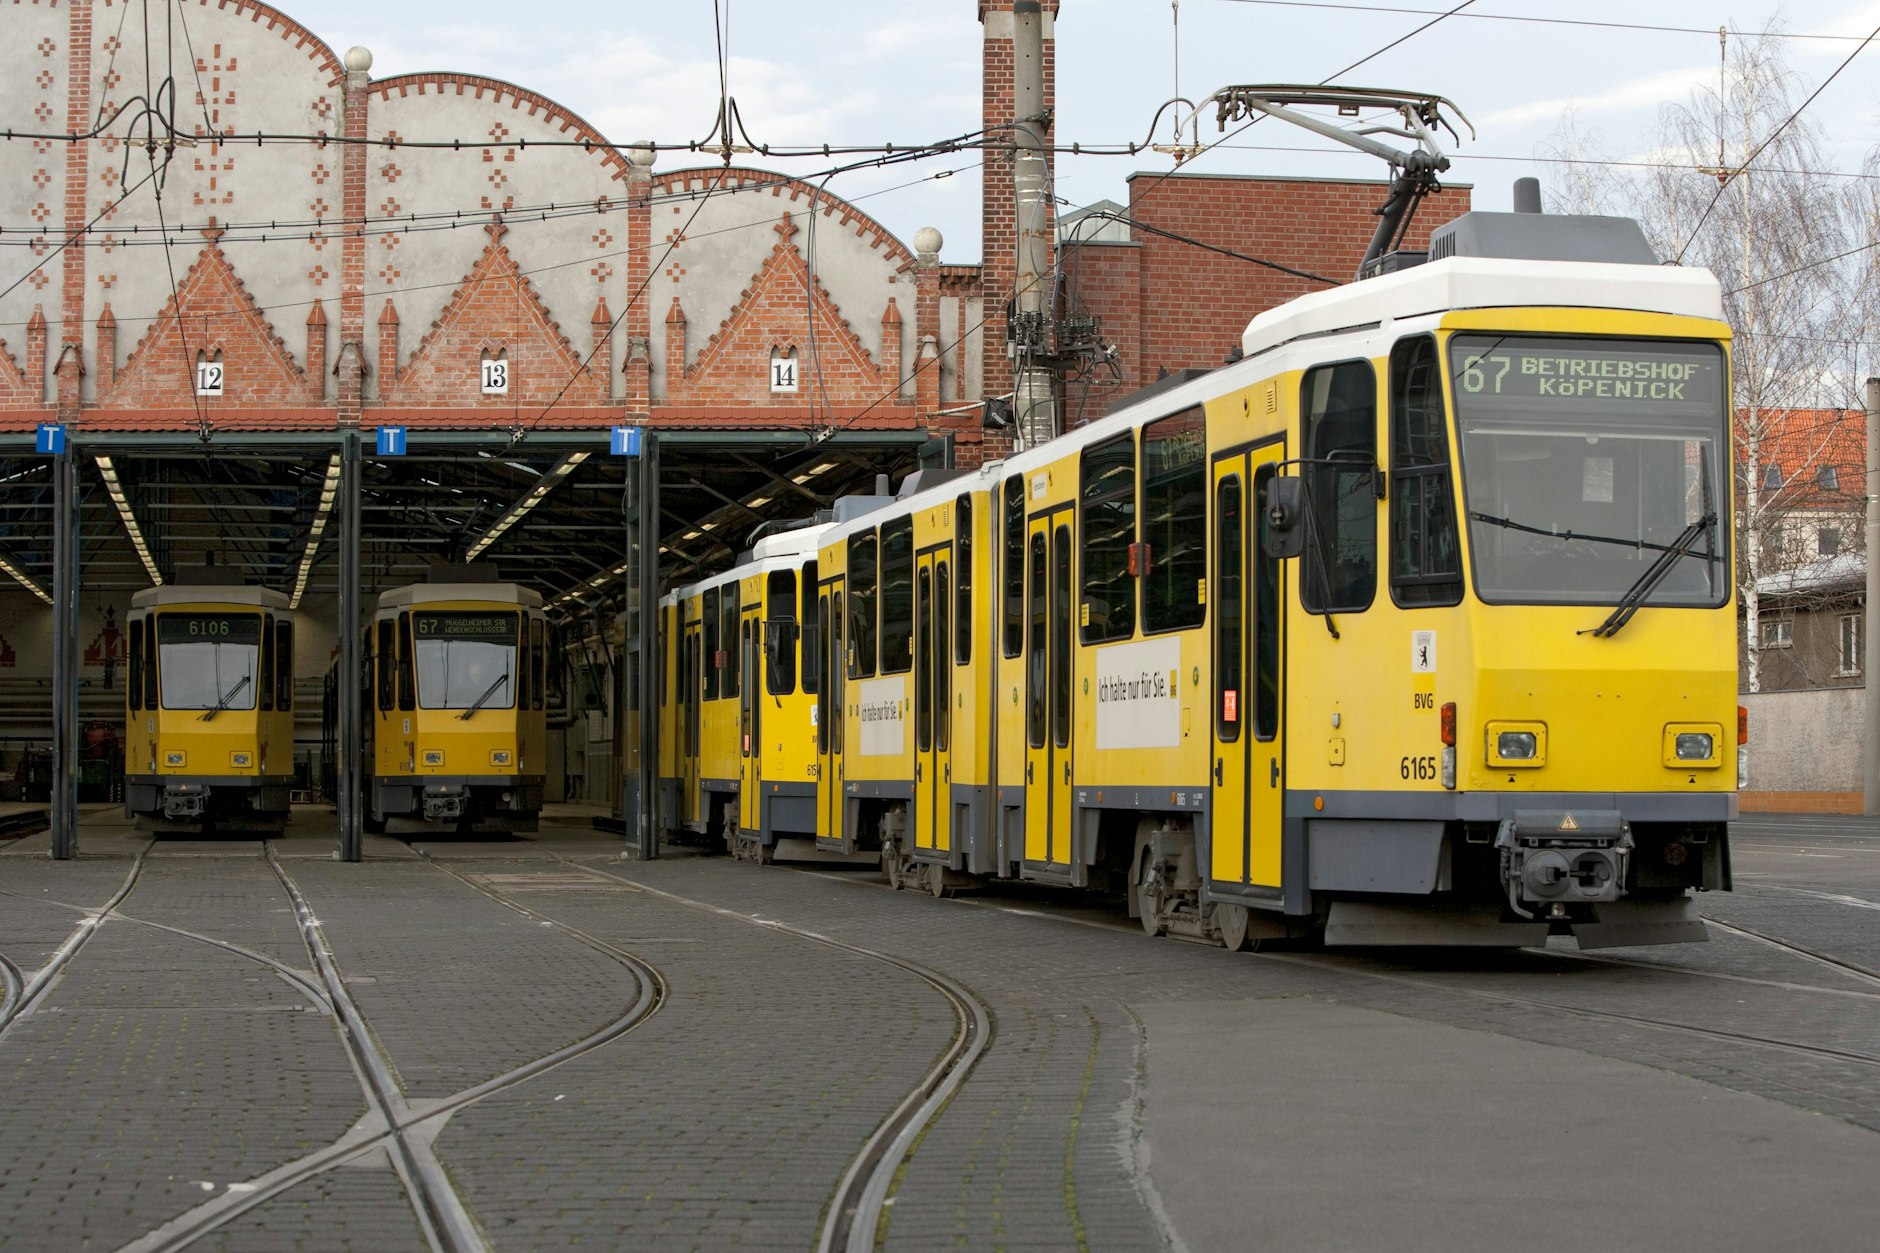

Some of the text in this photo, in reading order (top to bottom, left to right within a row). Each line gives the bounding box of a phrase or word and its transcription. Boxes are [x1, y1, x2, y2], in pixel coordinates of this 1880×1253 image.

[198, 367, 222, 390] 12
[483, 364, 506, 388] 13
[773, 364, 796, 387] 14
[1463, 355, 1700, 393] 67 BETRIEBSHOF
[43, 427, 60, 450] T
[383, 429, 400, 452] T
[617, 428, 635, 453] T
[189, 620, 229, 635] 6106
[419, 619, 438, 634] 67
[1099, 670, 1167, 703] Ich halte nur für Sie.
[1414, 693, 1433, 709] BVG
[807, 764, 817, 776] 615
[1401, 756, 1436, 780] 6165
